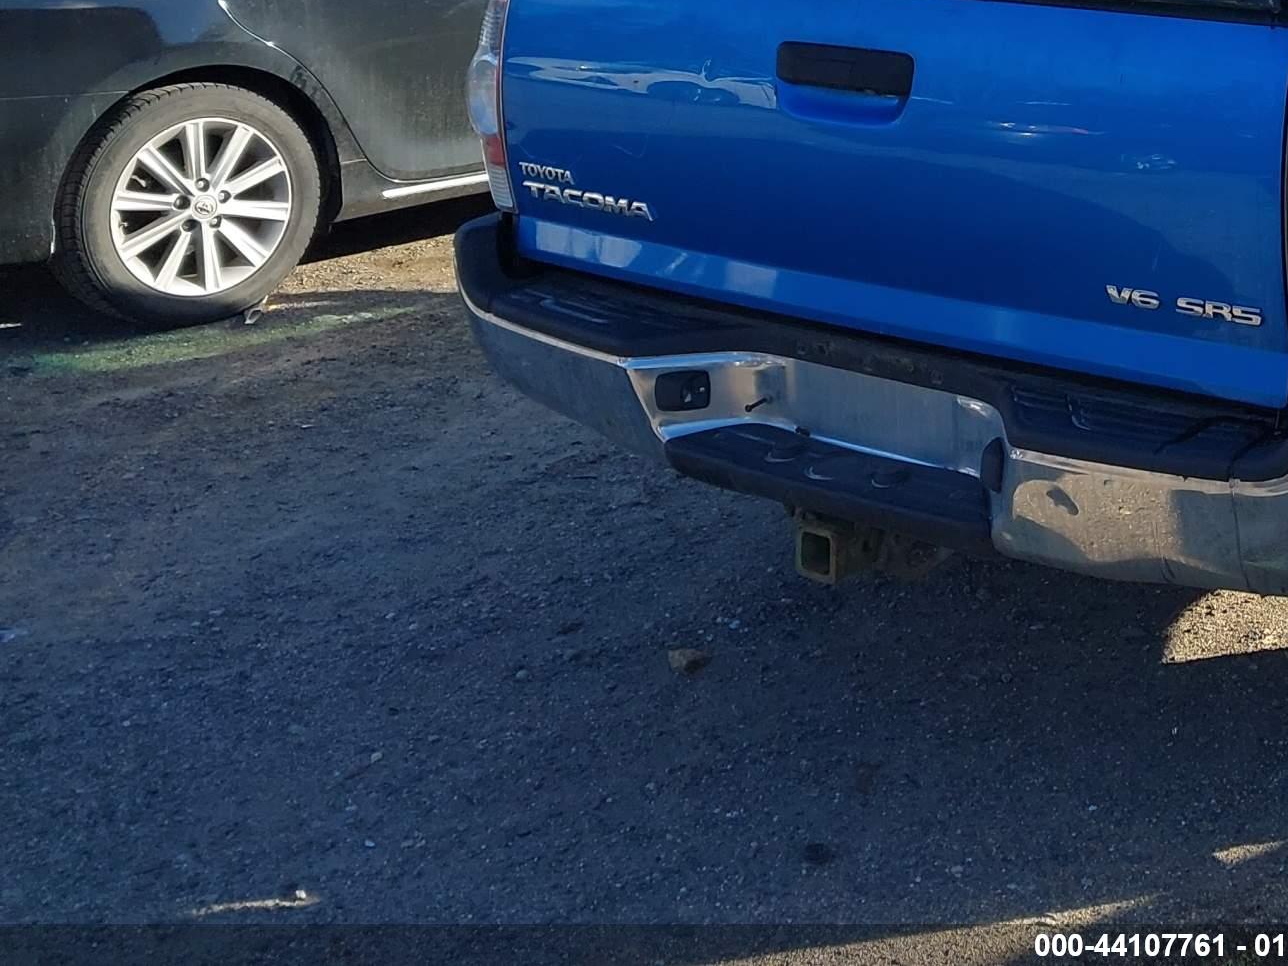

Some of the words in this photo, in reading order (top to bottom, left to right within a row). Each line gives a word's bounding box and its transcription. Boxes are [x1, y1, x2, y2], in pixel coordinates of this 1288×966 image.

[519, 161, 575, 185] TOYOTA
[522, 180, 653, 222] TACOMA
[1105, 284, 1160, 310] V6
[1175, 297, 1263, 327] SR5
